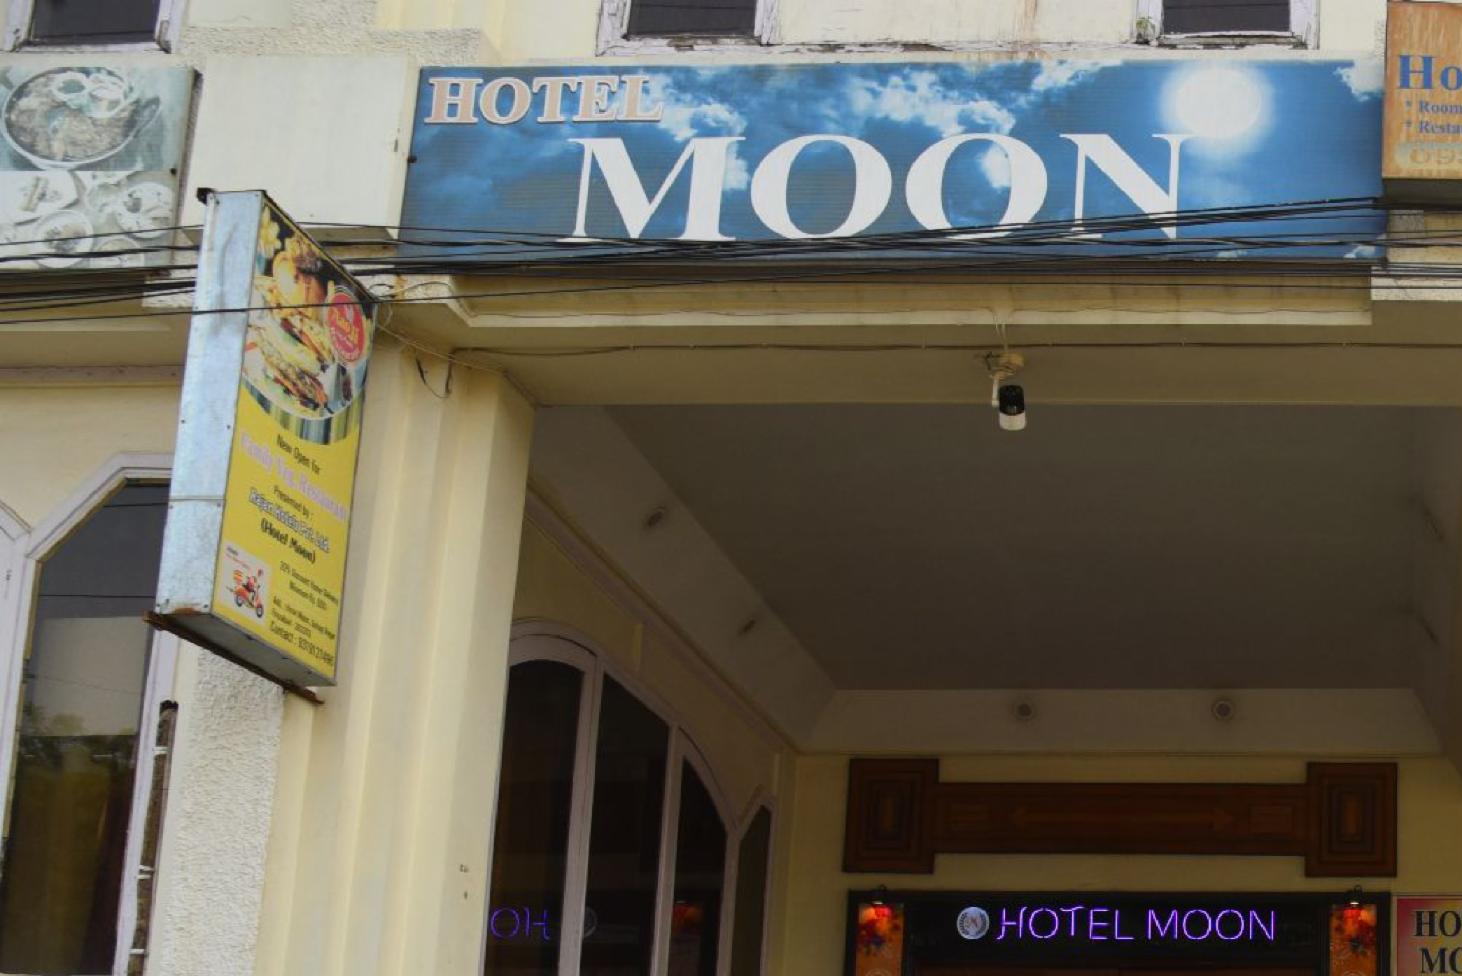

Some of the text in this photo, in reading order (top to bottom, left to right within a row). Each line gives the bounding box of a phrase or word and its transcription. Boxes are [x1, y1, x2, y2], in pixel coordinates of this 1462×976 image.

[425, 76, 663, 125] HOTEL
[555, 132, 1204, 242] MOON
[996, 905, 1135, 941] HOTEL
[1147, 908, 1275, 941] MOON
